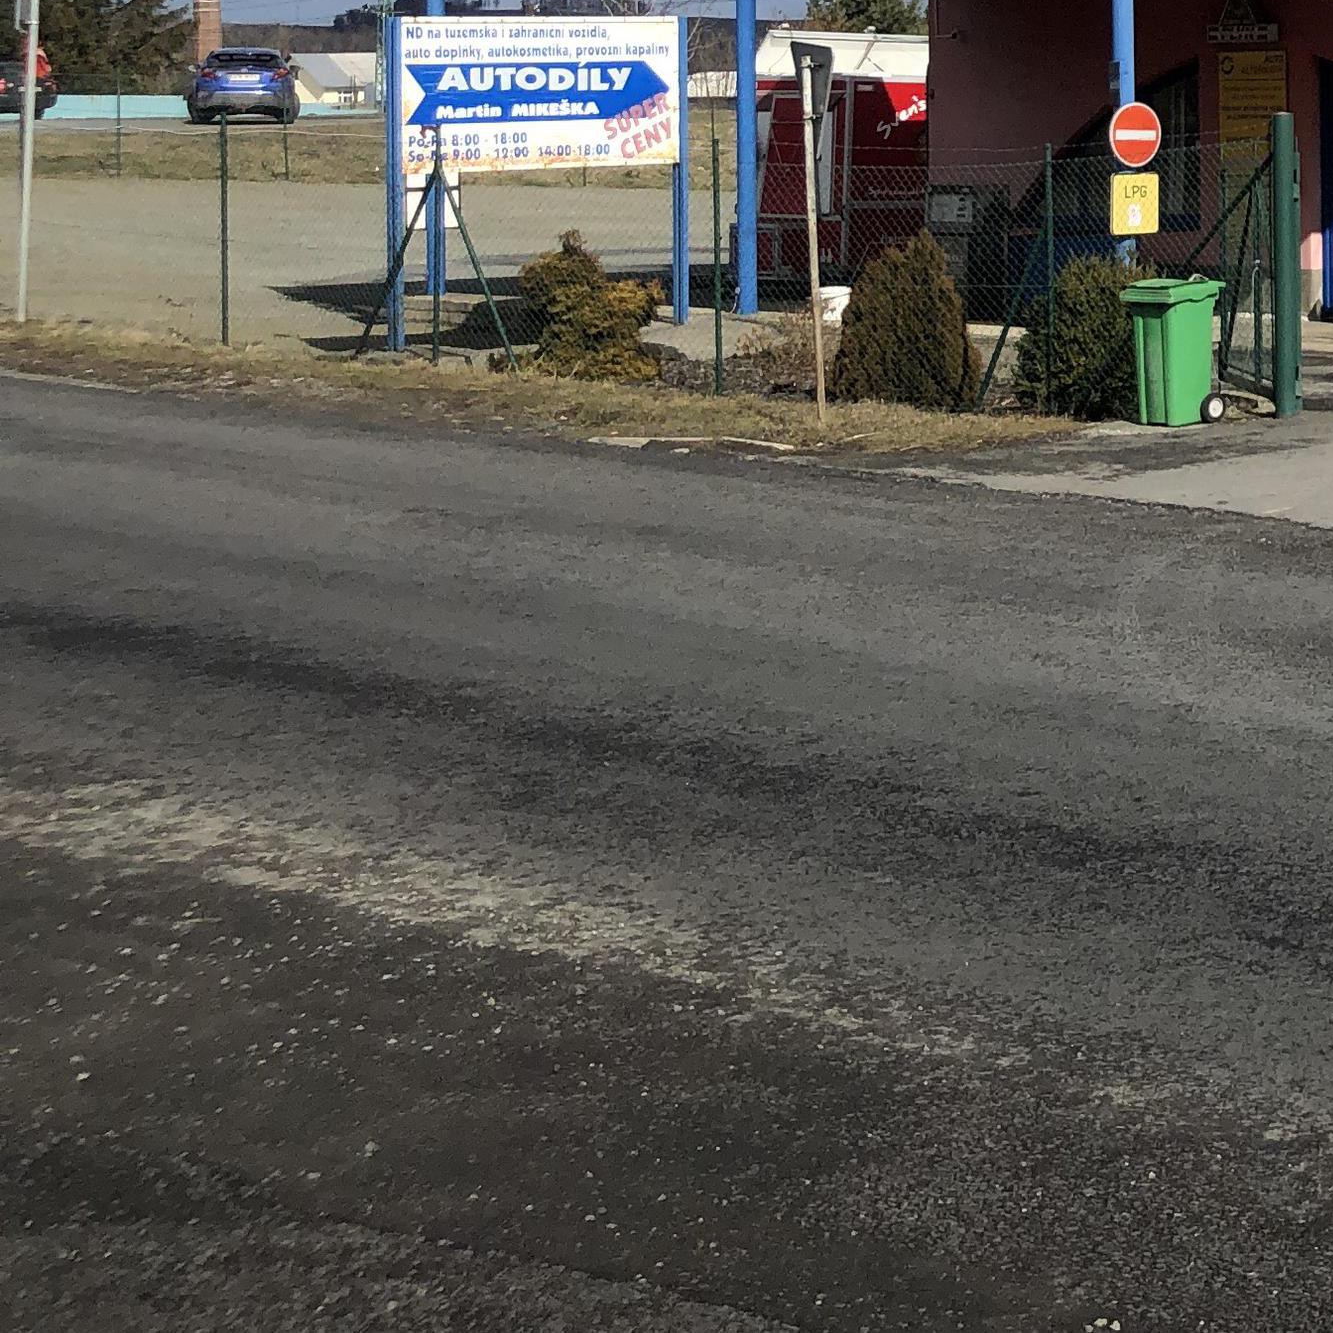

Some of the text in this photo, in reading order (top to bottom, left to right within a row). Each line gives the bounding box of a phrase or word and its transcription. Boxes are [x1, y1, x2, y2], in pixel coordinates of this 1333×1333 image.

[406, 26, 423, 40] ND
[428, 29, 441, 39] na
[404, 48, 431, 59] auto
[436, 61, 633, 92] AUTODÍLY
[436, 98, 600, 120] Martin MIKEŠKA
[604, 91, 671, 140] SUPER
[494, 131, 528, 145] 18:00
[620, 116, 672, 159] CENY
[453, 147, 481, 161] 9:00
[1124, 185, 1148, 199] LPG
